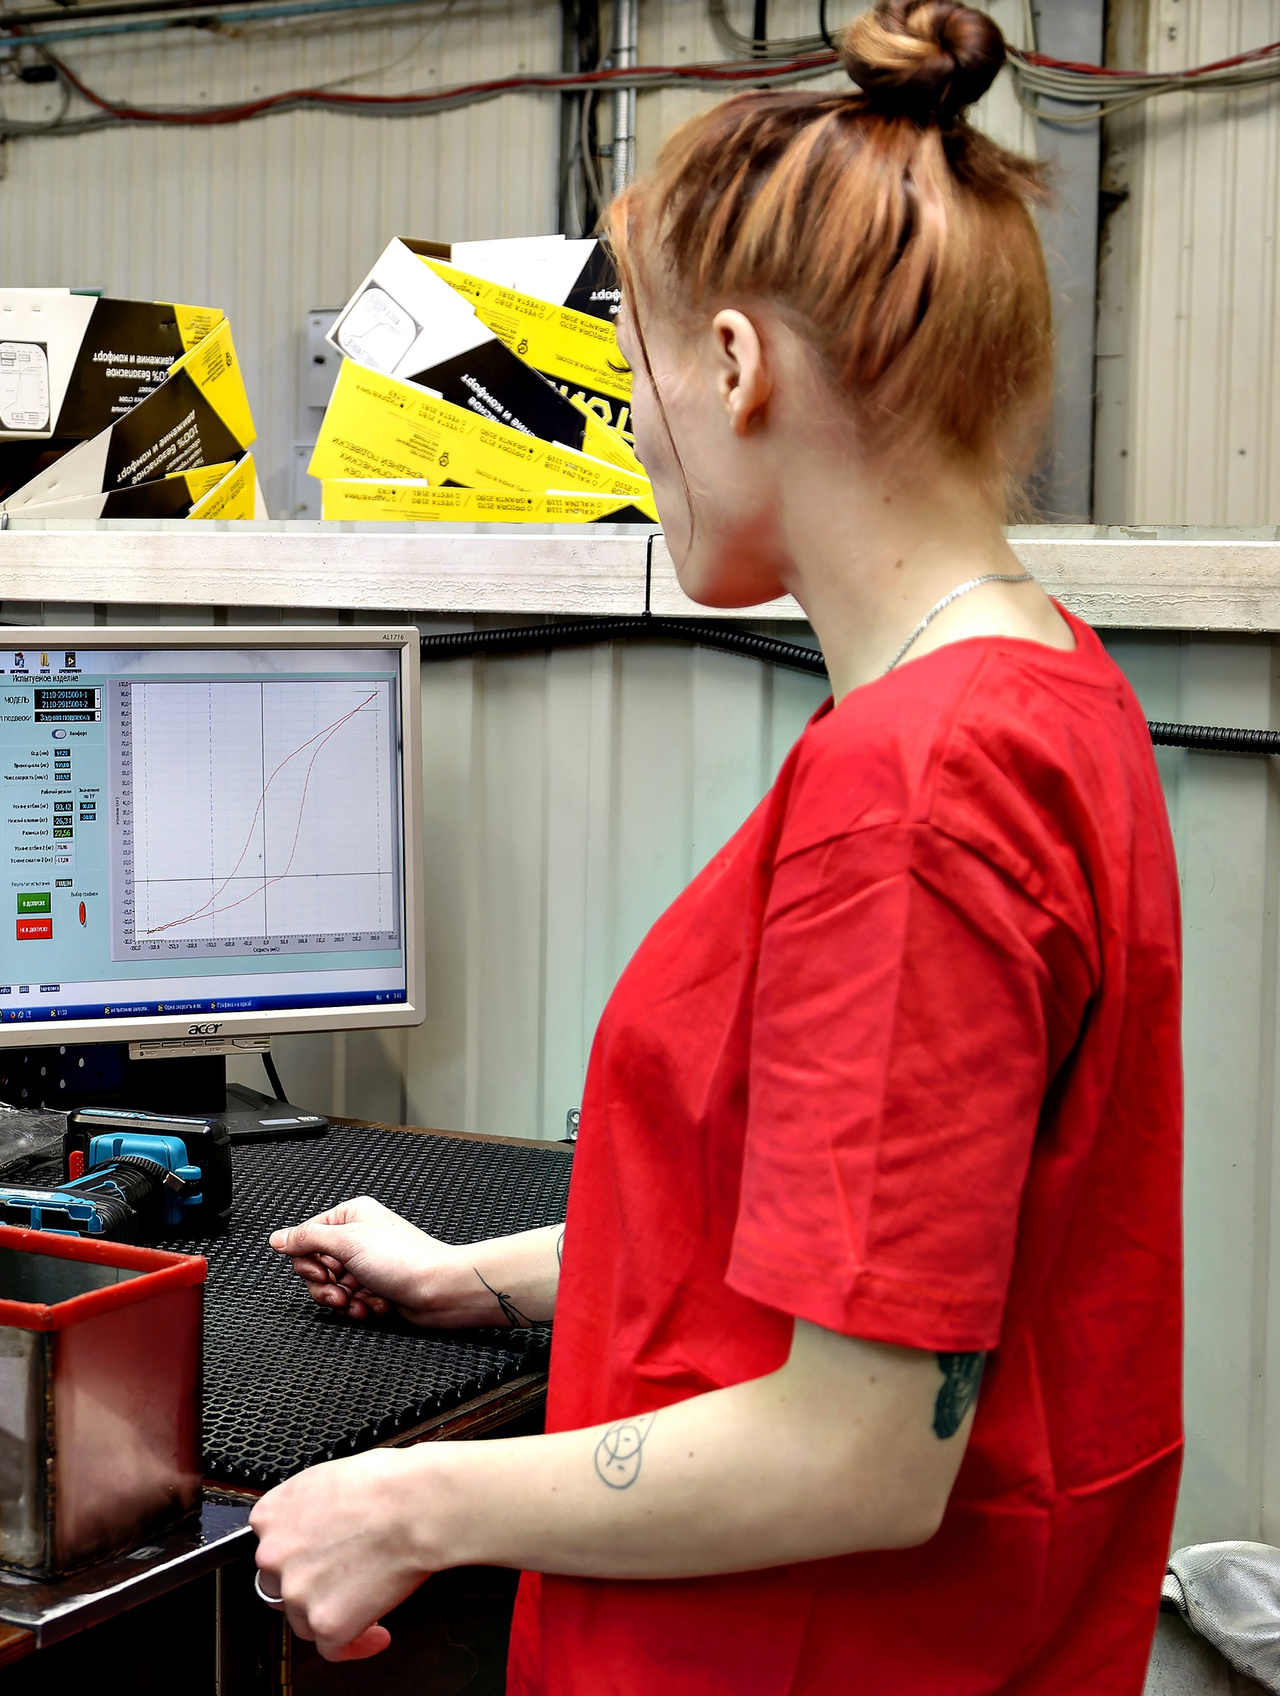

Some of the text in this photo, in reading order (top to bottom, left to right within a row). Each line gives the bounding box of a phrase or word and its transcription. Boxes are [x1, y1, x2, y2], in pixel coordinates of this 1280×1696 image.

[590, 289, 623, 302] форт
[92, 350, 128, 363] комфорт
[137, 354, 174, 364] движение
[106, 368, 169, 382] 00% безопасное
[461, 373, 503, 413] комфорт
[159, 409, 195, 445] движение
[176, 423, 198, 446] 100%
[116, 448, 151, 483] комфорт
[131, 444, 176, 485] безопасное
[13, 675, 51, 683] Испытуемое
[188, 1023, 222, 1035] acer
